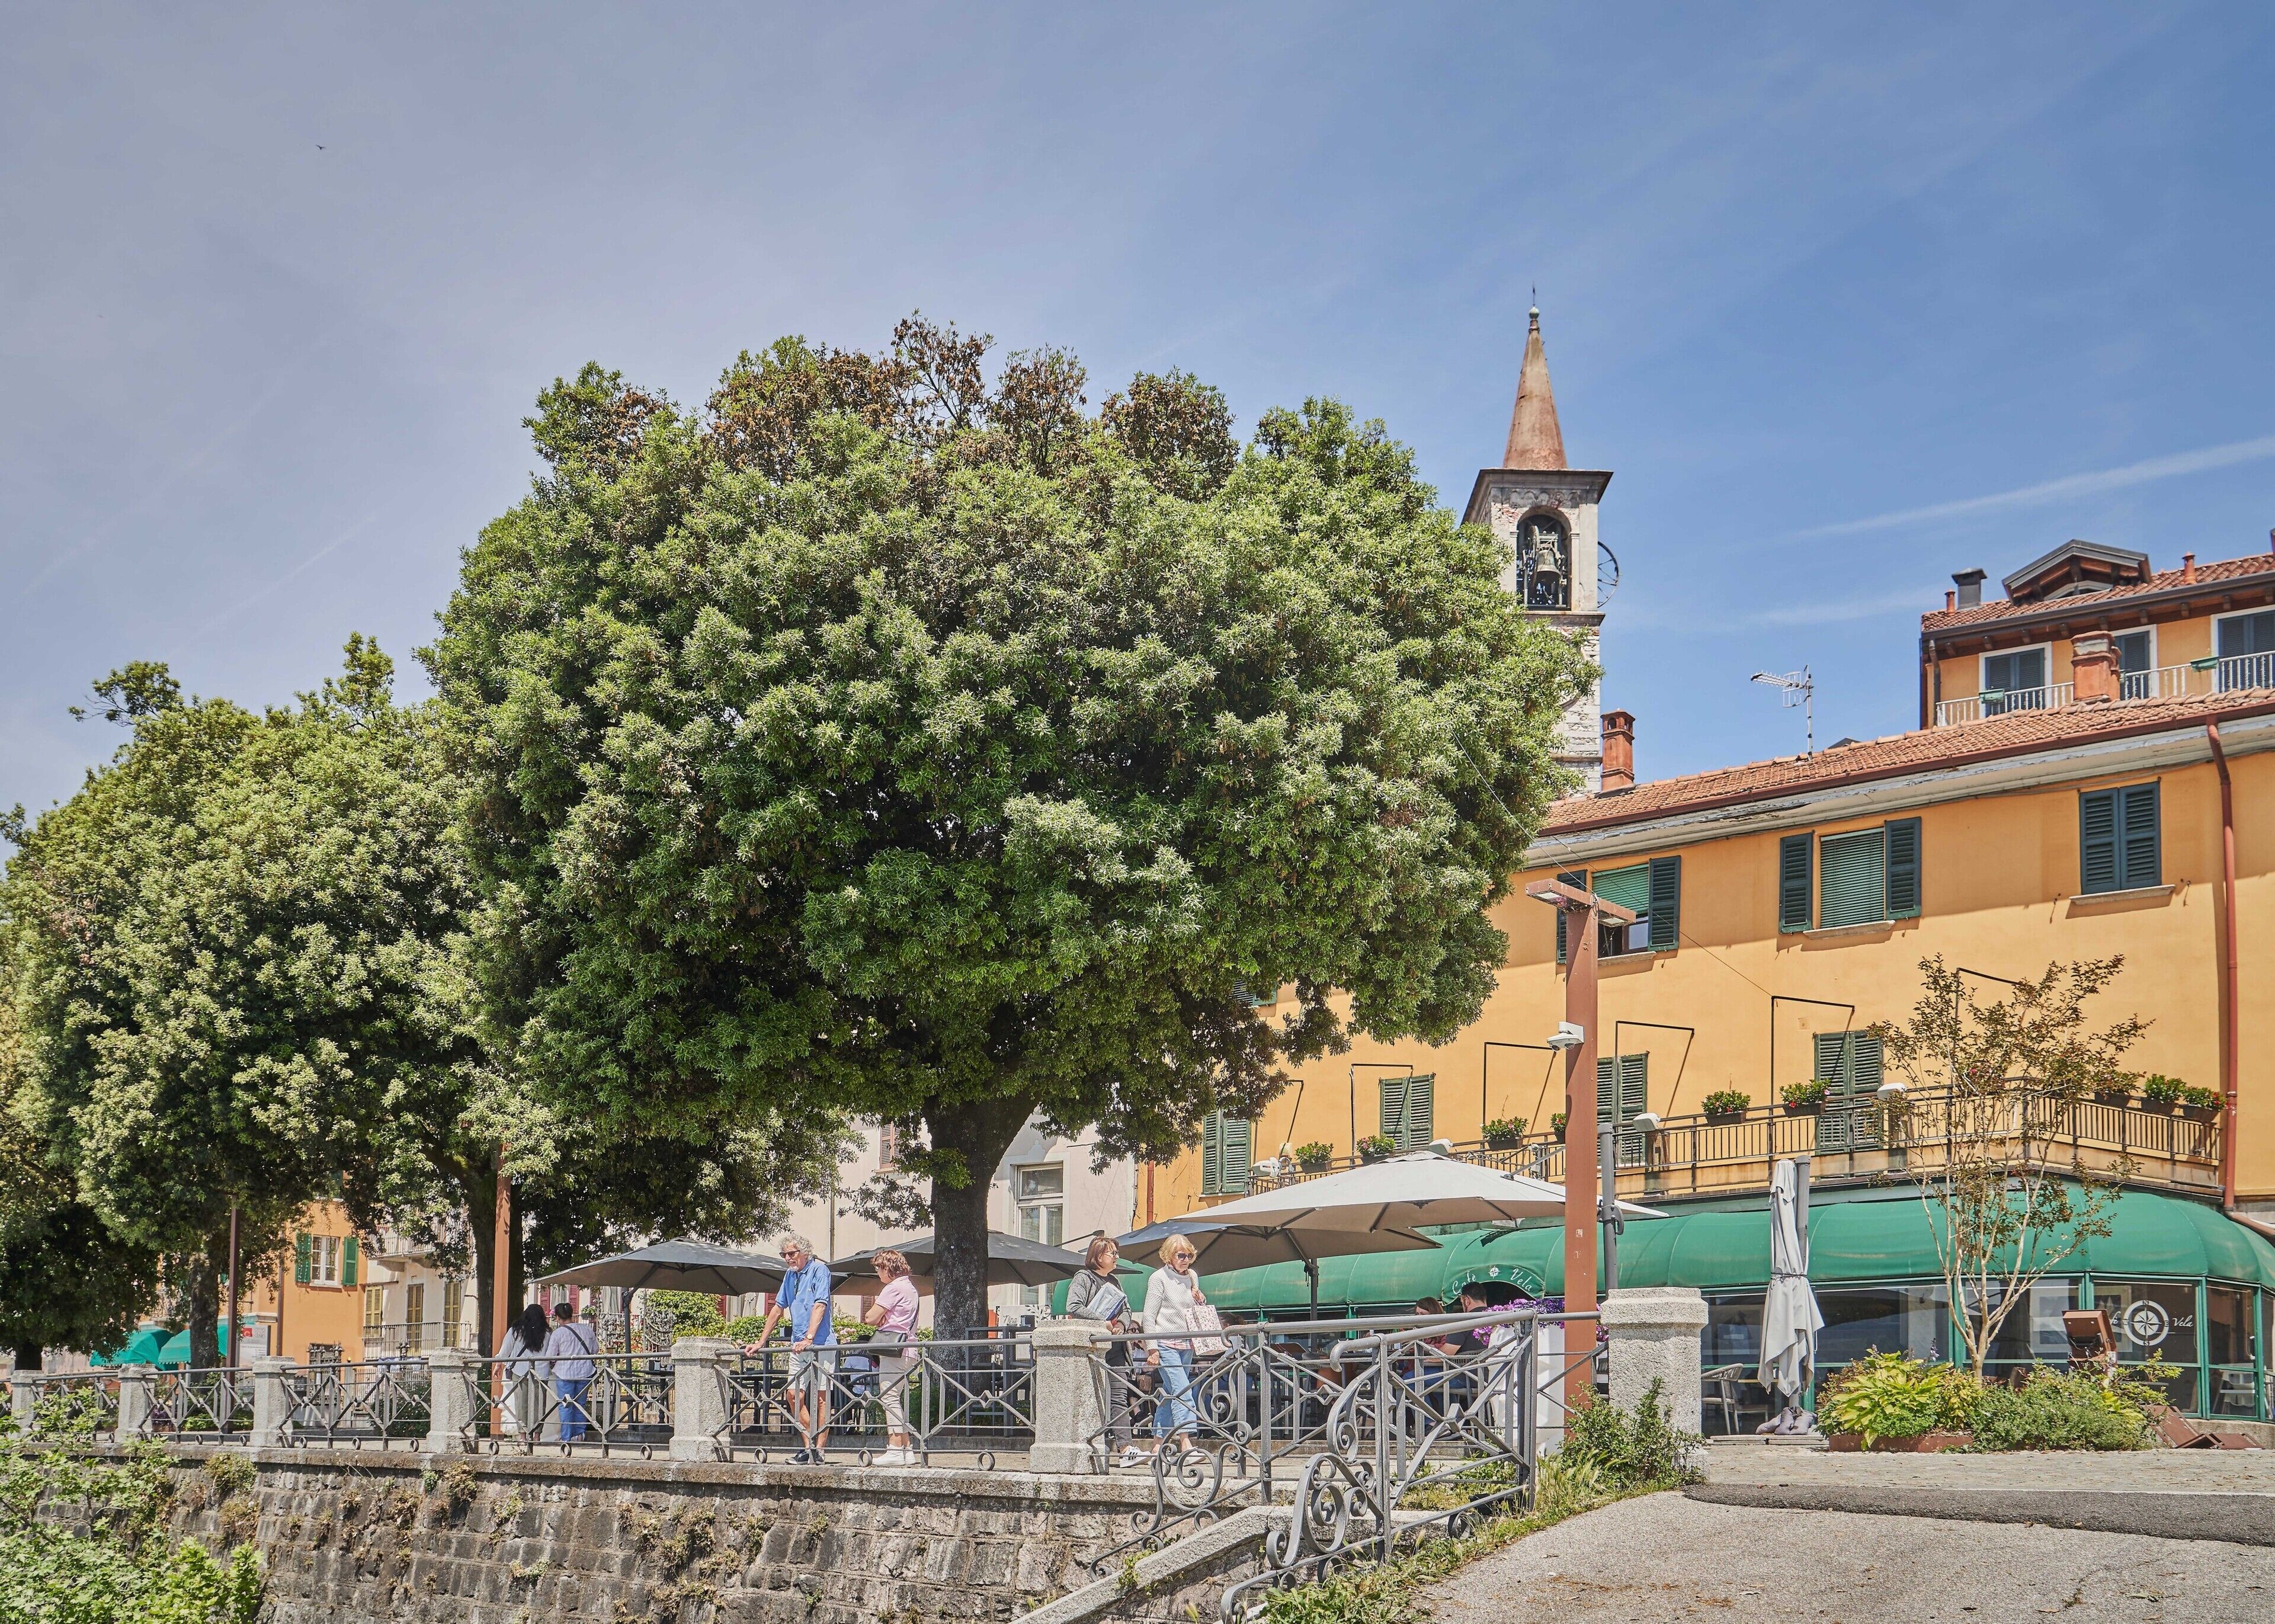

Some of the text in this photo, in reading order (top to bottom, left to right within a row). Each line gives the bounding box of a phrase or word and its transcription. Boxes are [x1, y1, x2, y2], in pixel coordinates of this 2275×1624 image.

[1510, 1268, 1532, 1291] Vela
[1003, 1315, 1018, 1324] Nina
[2172, 1315, 2193, 1327] Vela
